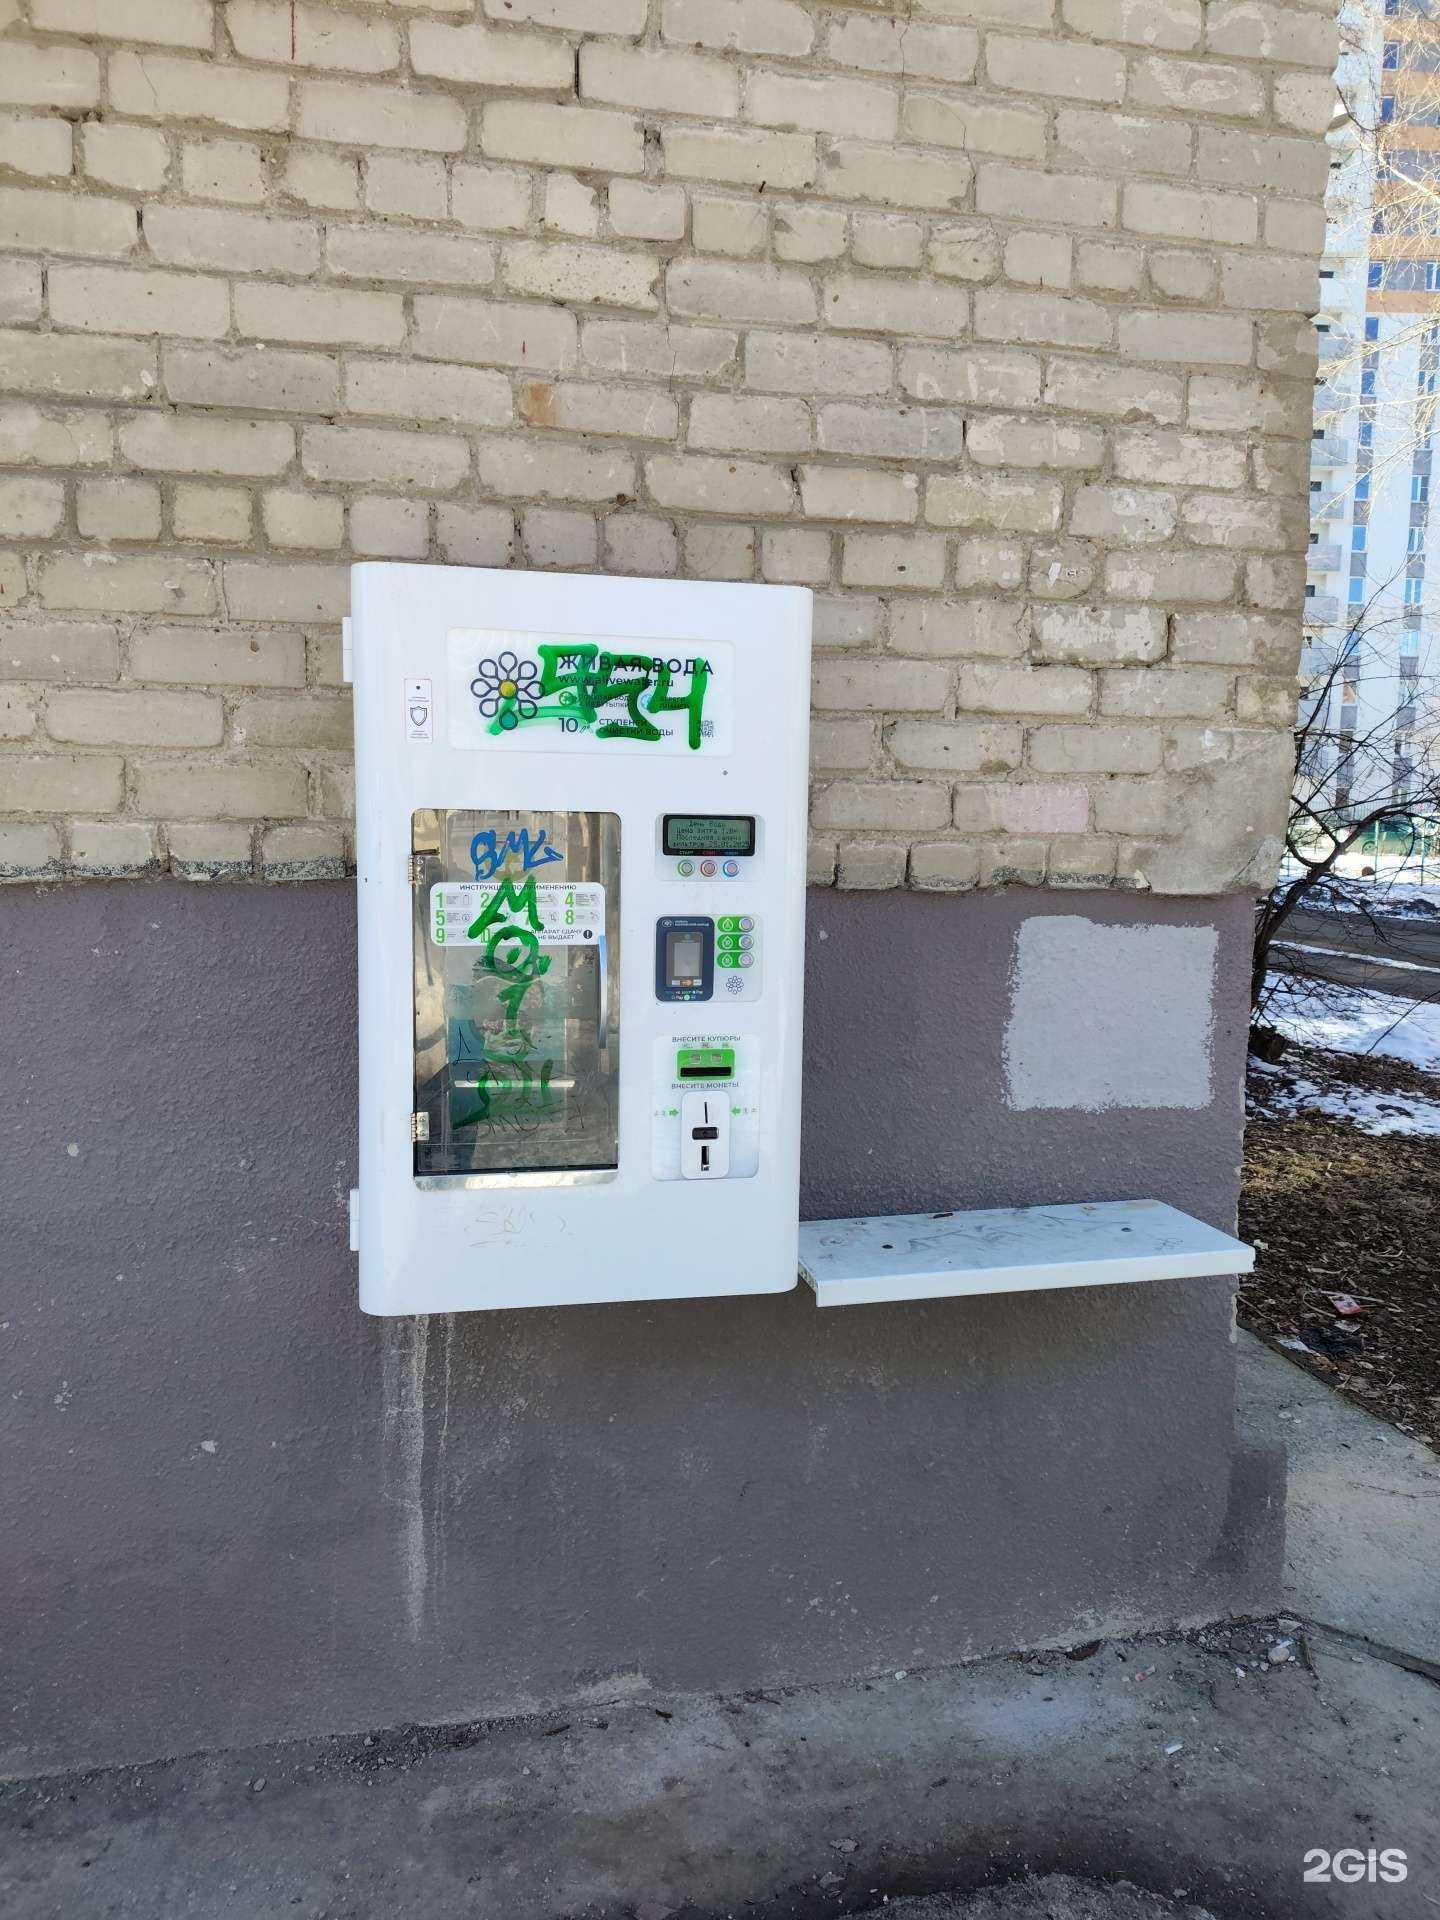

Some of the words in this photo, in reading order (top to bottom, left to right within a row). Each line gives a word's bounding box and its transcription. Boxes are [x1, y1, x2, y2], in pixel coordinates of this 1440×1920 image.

[559, 655, 642, 671] ЖИВАЯ
[651, 657, 714, 675] ВОДА
[559, 717, 579, 732] 10
[645, 728, 674, 737] ВОДЫ
[436, 892, 444, 907] 1
[480, 892, 490, 908] 2
[565, 892, 574, 907] 4
[435, 910, 445, 925] 5
[565, 910, 574, 925] 8
[435, 928, 445, 943] 9
